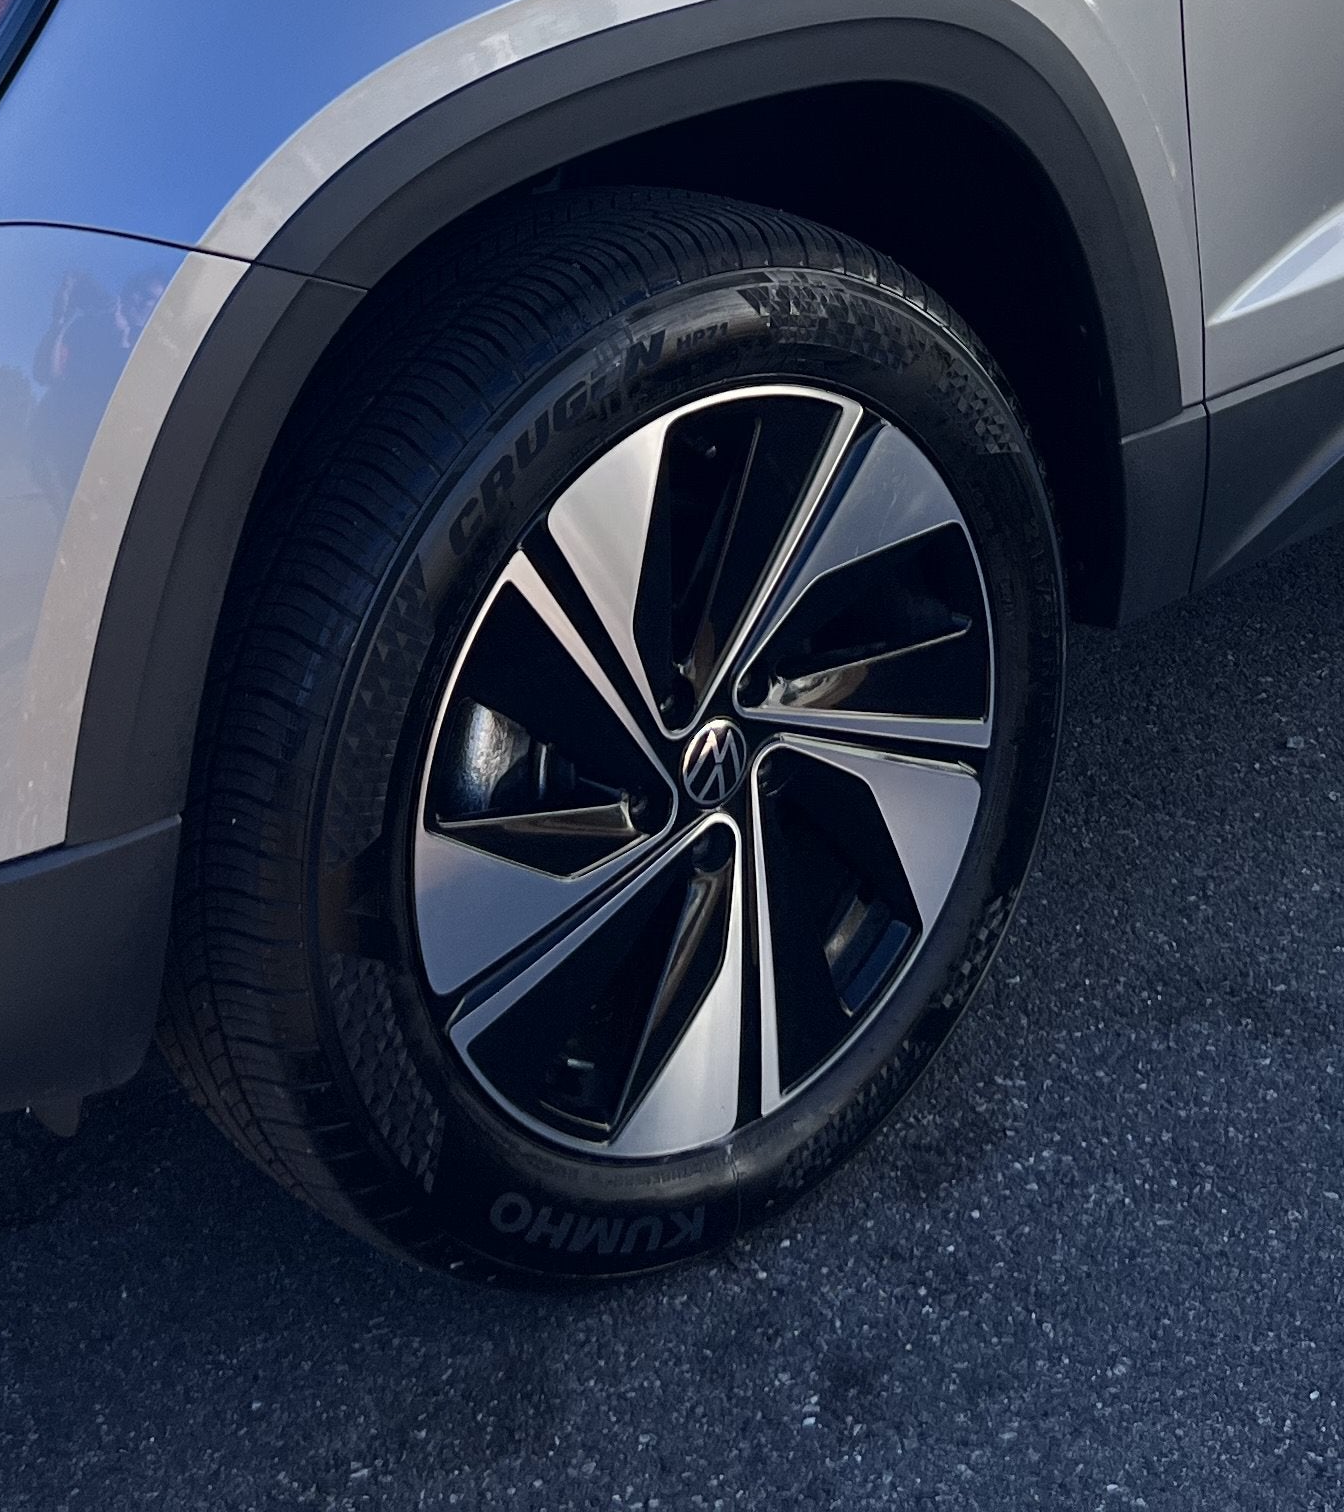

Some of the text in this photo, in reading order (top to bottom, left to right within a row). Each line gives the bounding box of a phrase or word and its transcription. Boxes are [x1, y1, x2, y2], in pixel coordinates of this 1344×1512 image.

[449, 321, 729, 557] CRUGEN HP71
[489, 1191, 706, 1256] KUMHO
